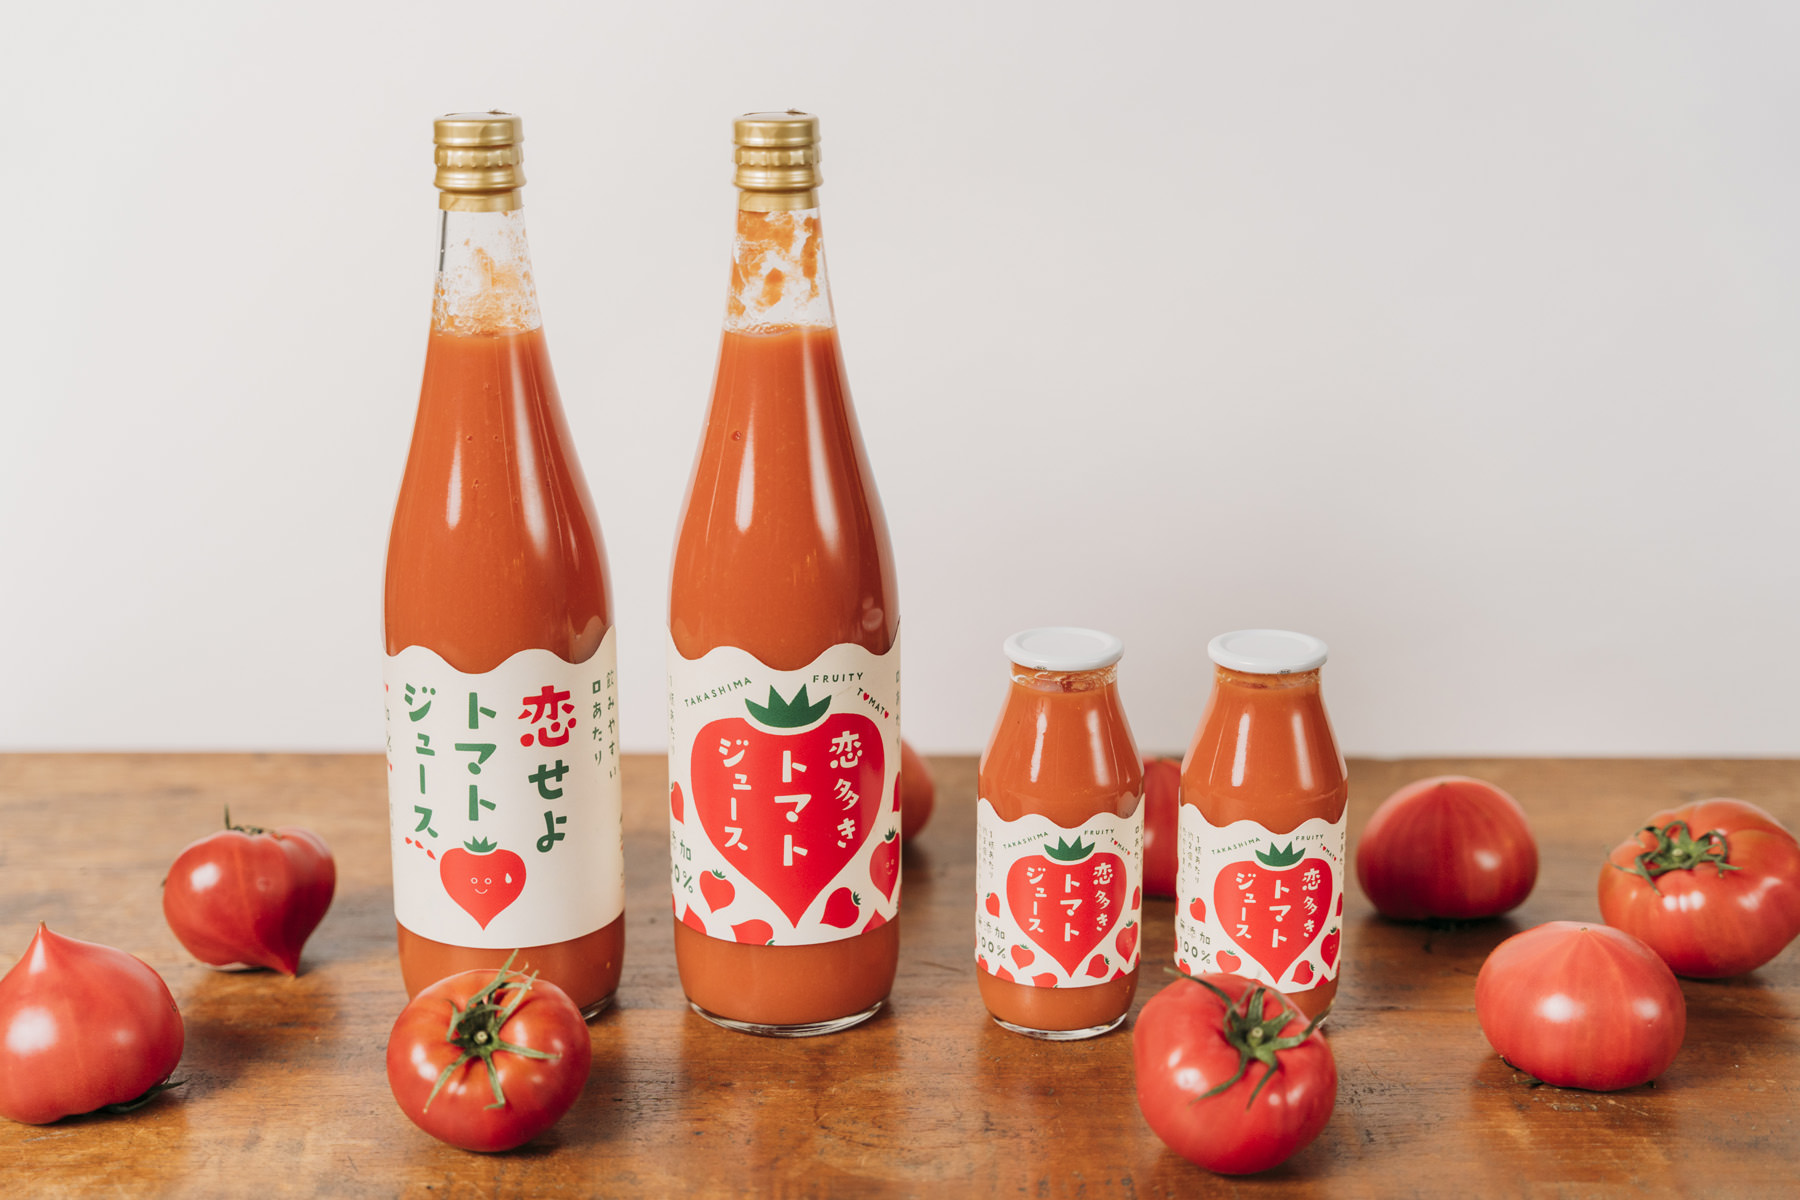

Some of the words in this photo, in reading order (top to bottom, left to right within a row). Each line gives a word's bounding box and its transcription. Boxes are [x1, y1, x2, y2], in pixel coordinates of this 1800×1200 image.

[592, 680, 603, 766] 口あたり
[684, 676, 752, 707] TAKASHIMA
[812, 671, 864, 684] FRUITY
[404, 682, 439, 839] ジュース
[454, 691, 497, 822] トマト
[517, 684, 577, 853] 恋せよ
[829, 730, 863, 849] 恋多き
[718, 737, 751, 851] ジュース
[774, 750, 812, 867] トマト
[1003, 832, 1049, 849] TAKASHIMA
[1083, 828, 1115, 836] FRUITY
[1211, 837, 1261, 855] TAKASHIMA
[1295, 833, 1324, 841] FRUITY
[1026, 866, 1048, 934] ジュース
[1059, 873, 1083, 942] トマト
[1092, 862, 1114, 932] 恋多き
[1235, 872, 1257, 939] ジュース
[1269, 879, 1292, 948] トマト
[1302, 867, 1321, 938] 恋多き
[1179, 936, 1211, 964] 100%
